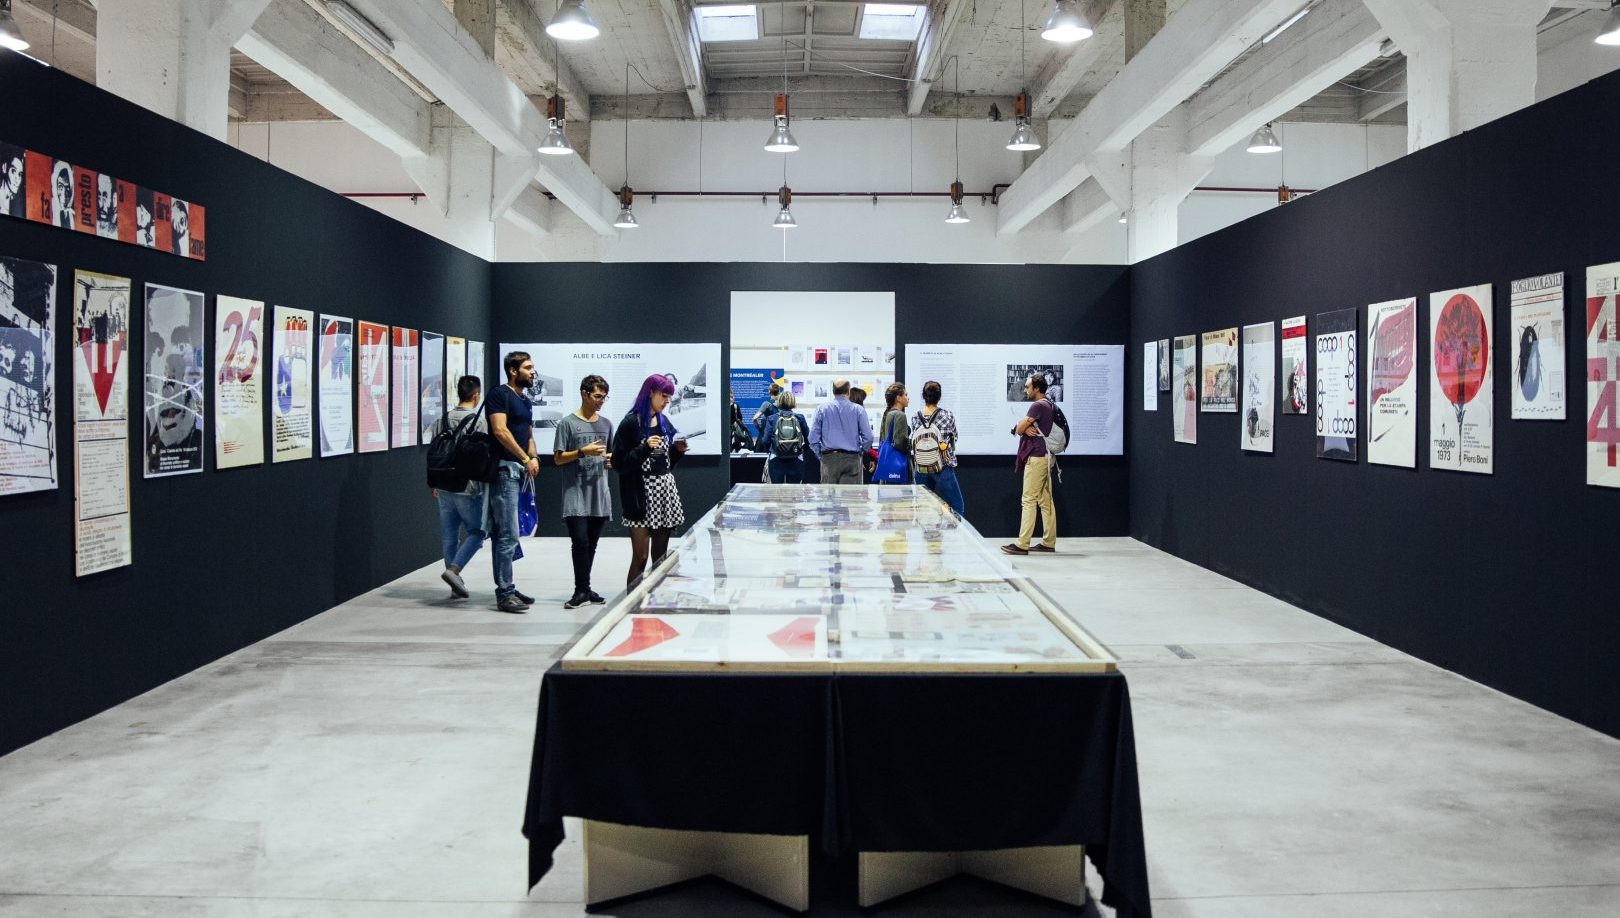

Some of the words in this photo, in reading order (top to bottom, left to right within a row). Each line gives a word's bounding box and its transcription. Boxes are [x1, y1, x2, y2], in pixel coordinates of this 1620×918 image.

[80, 173, 94, 227] presto
[219, 306, 262, 385] 25
[1442, 423, 1445, 435] 1
[1433, 438, 1456, 450] maggio
[1437, 450, 1451, 461] 1973
[1463, 454, 1476, 463] Piero
[1476, 455, 1488, 464] Boni
